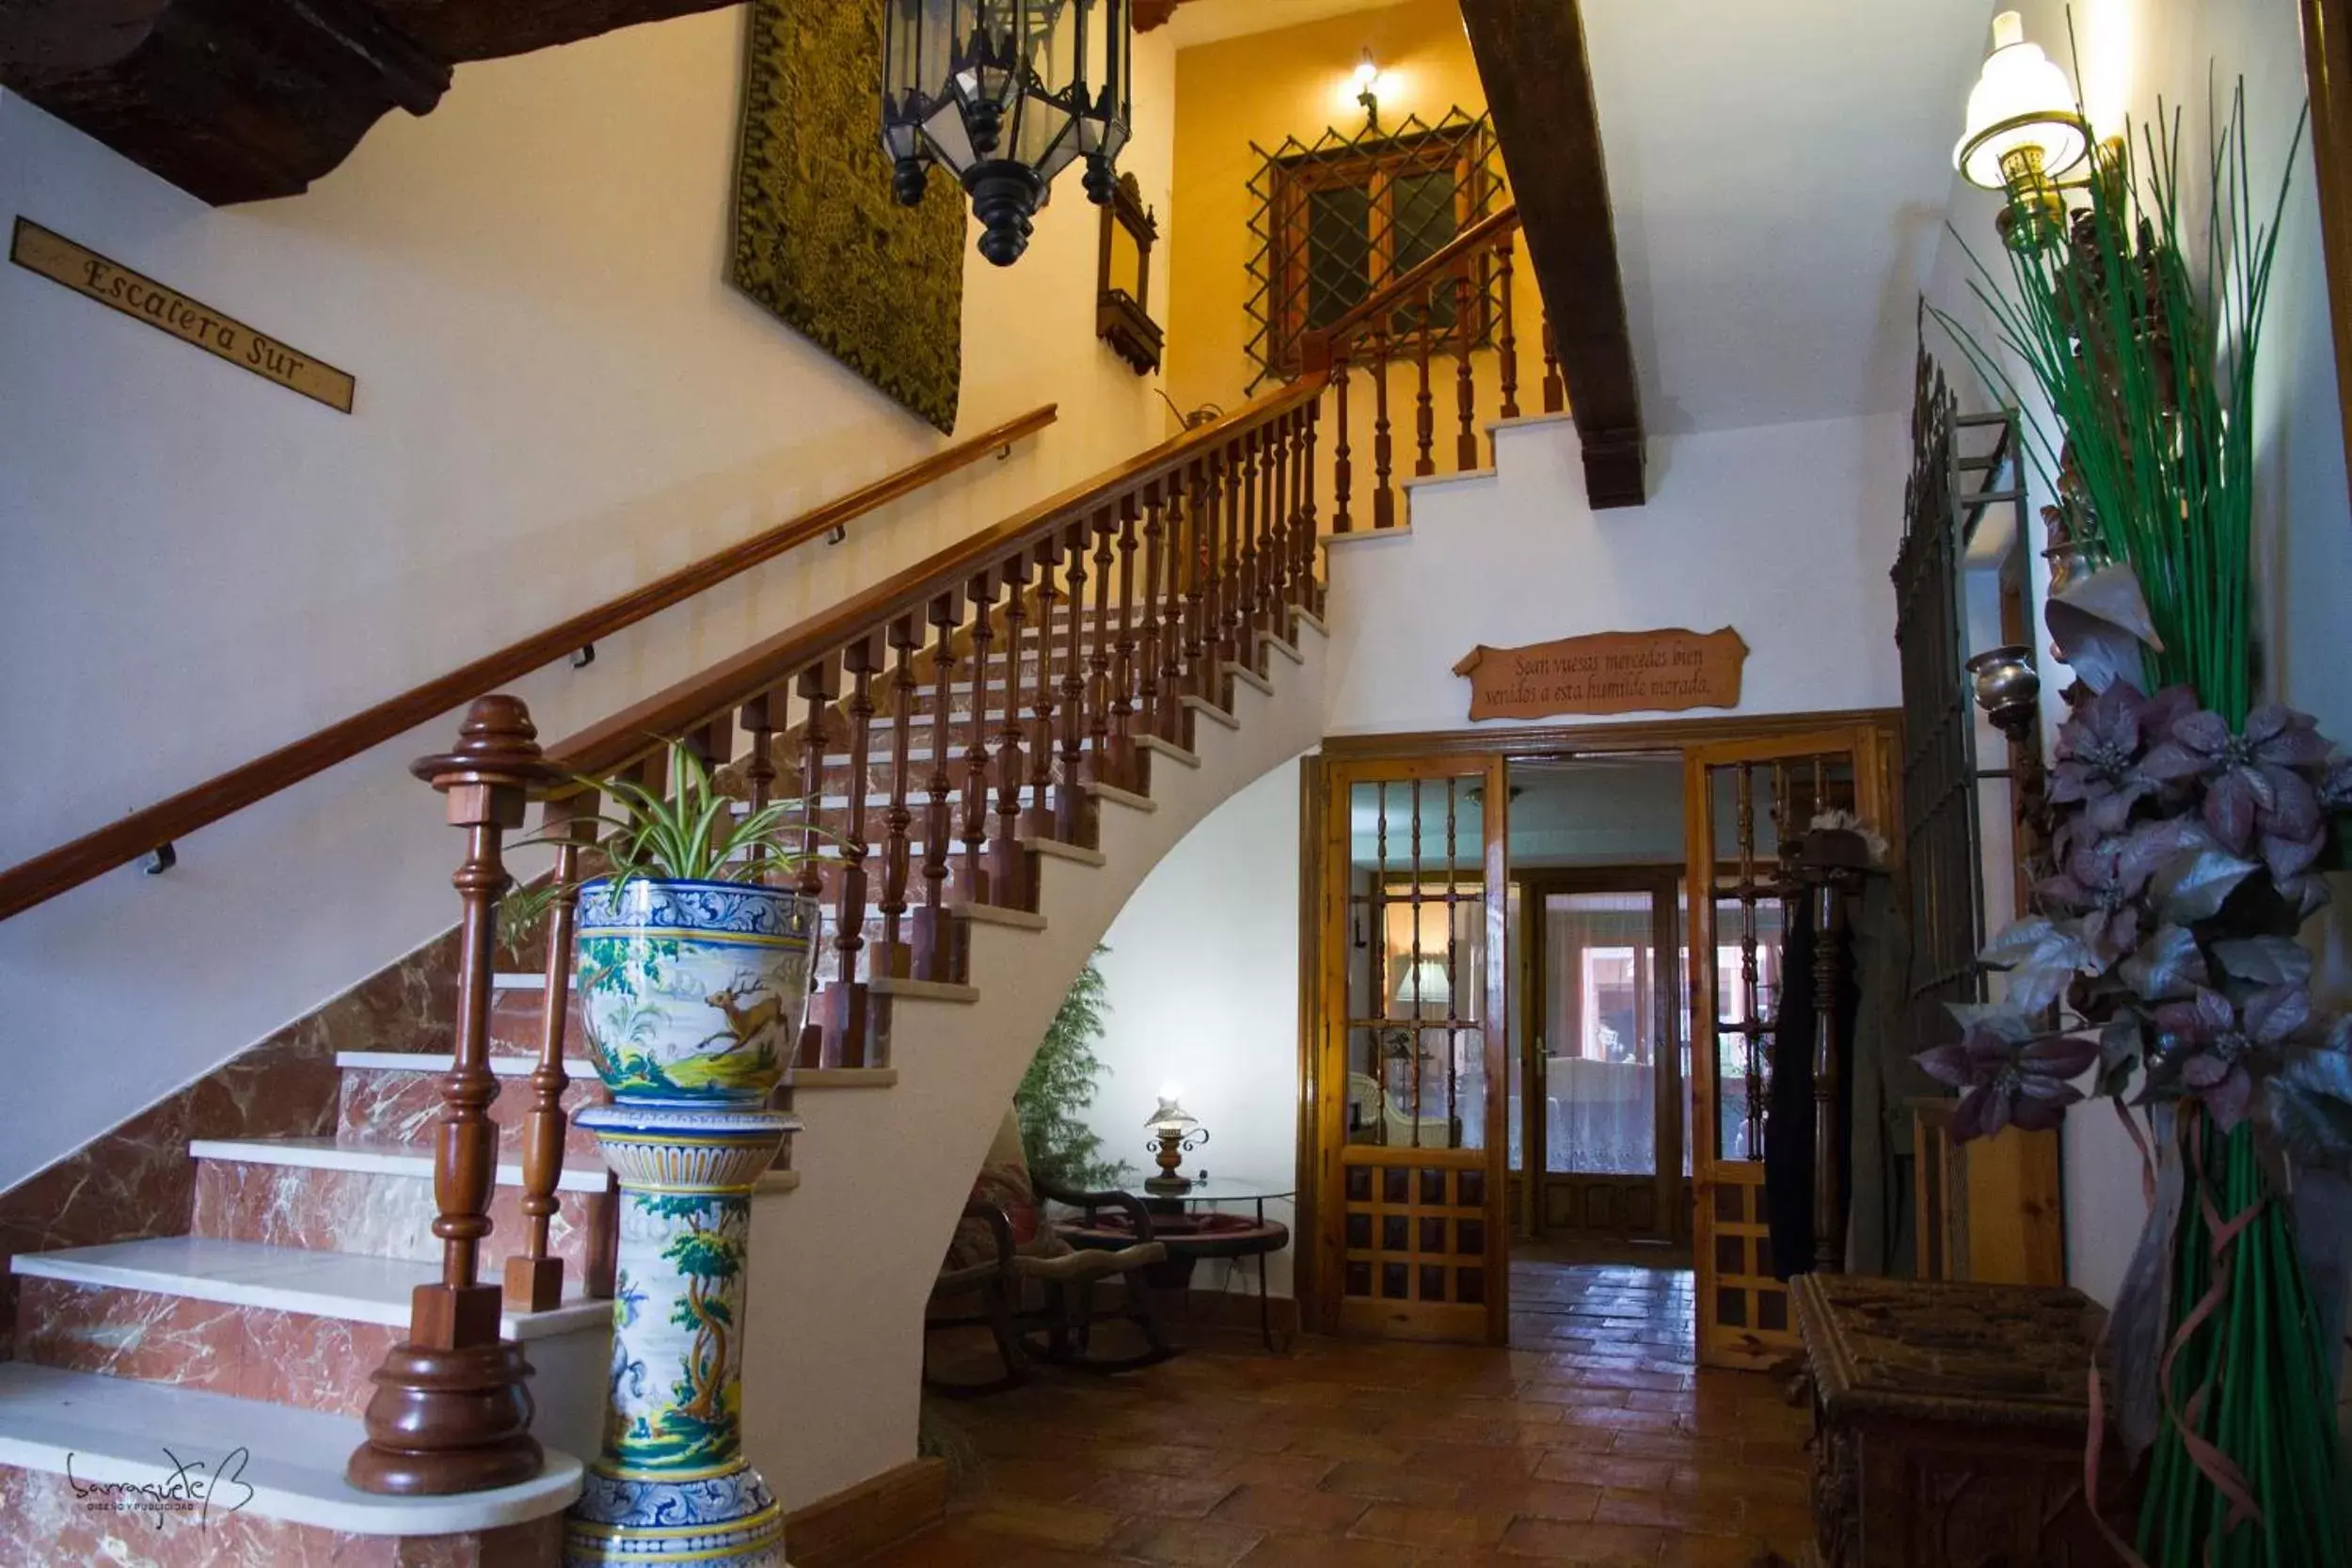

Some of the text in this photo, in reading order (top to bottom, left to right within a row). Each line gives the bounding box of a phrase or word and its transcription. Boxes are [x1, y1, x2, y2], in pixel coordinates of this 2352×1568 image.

[83, 260, 304, 380] Escalera Sur
[1515, 652, 1550, 676] Sean
[1605, 641, 1667, 669] mercedes
[1672, 640, 1704, 665] bien
[1485, 676, 1536, 705] venidos
[1540, 686, 1549, 703] a
[1554, 684, 1582, 702] esta
[1587, 671, 1645, 701] humilde
